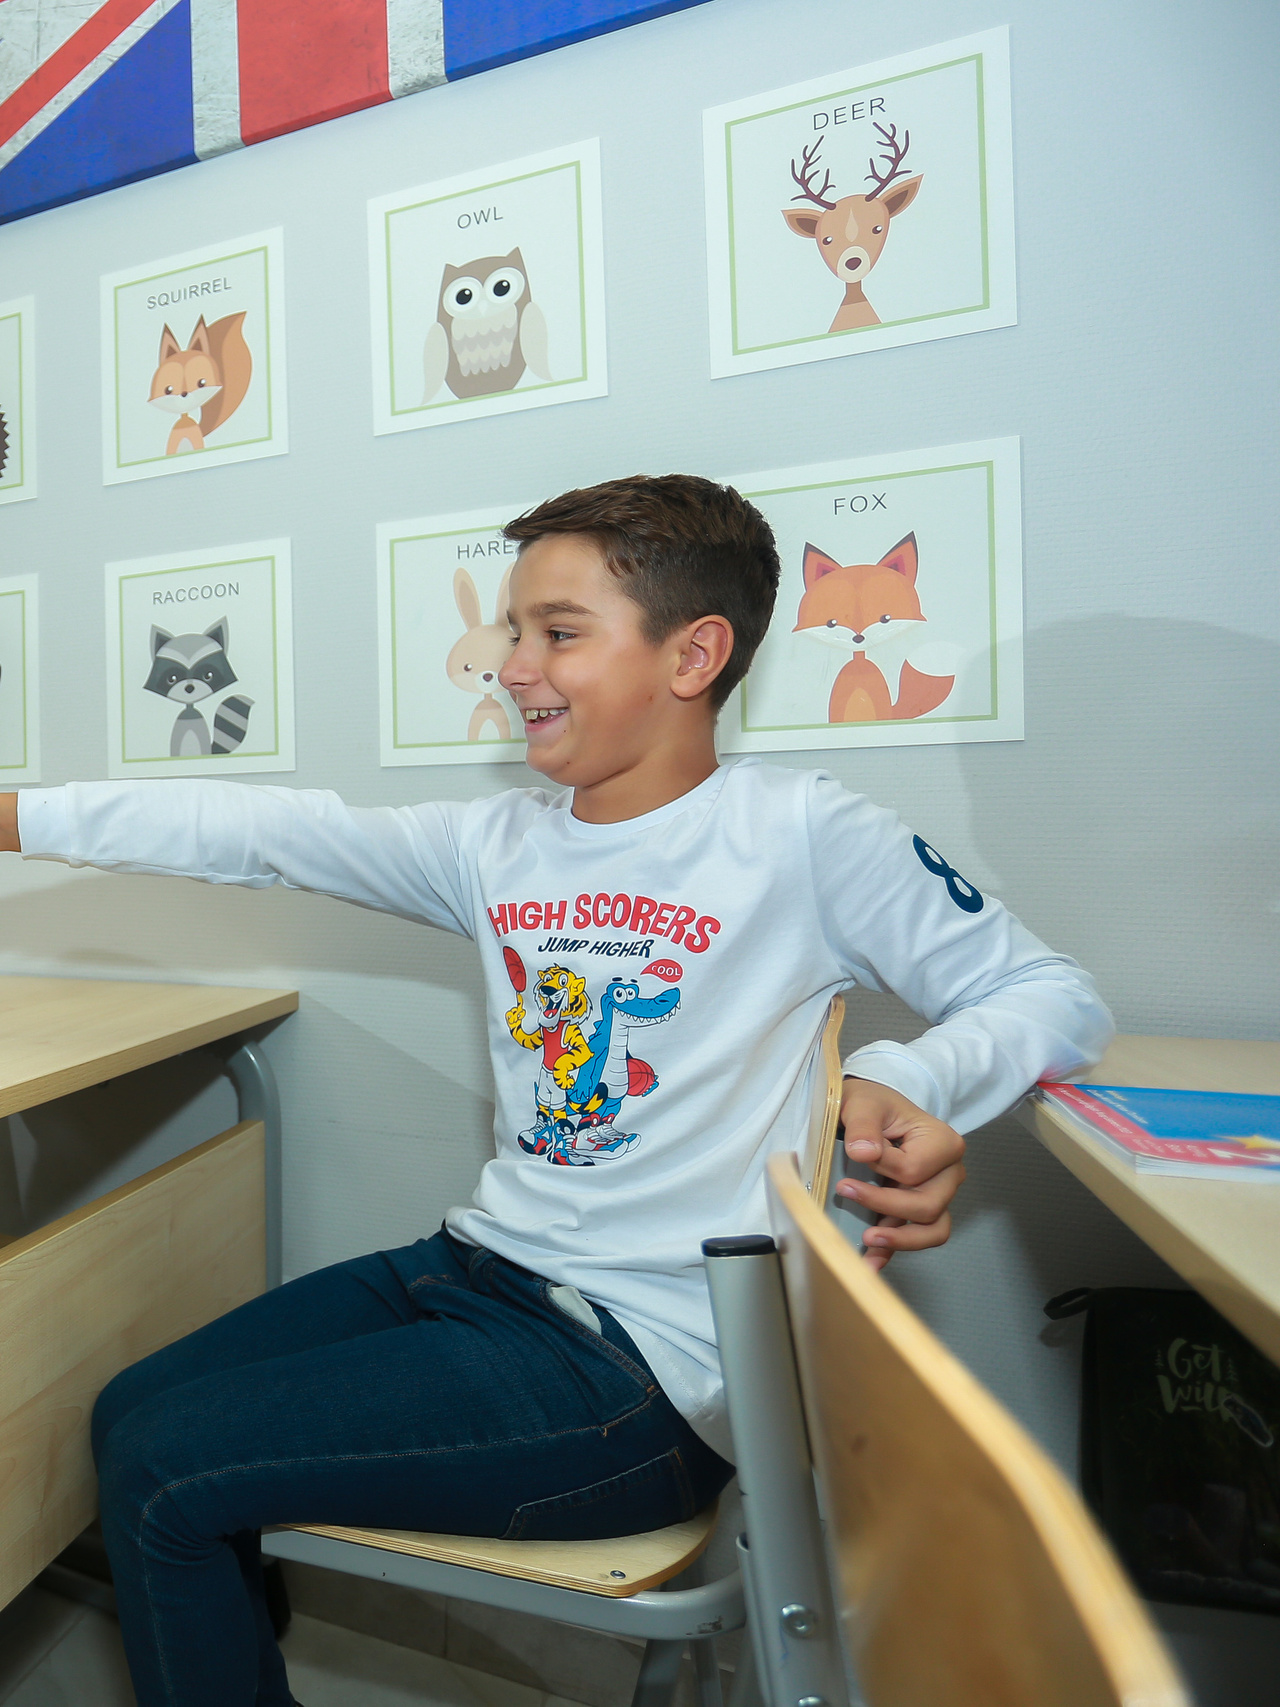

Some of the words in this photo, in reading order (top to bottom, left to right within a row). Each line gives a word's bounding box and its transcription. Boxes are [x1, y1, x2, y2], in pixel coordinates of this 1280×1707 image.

[813, 95, 887, 131] DEER
[456, 206, 504, 231] OWL
[146, 276, 232, 310] SQUIRREL
[832, 492, 888, 516] FOX
[456, 539, 515, 560] HARE
[152, 581, 241, 606] RACCOON
[912, 833, 984, 914] 8
[486, 899, 568, 938] HIGH
[572, 892, 722, 955] SCORERS
[538, 936, 589, 953] JUMP
[587, 938, 655, 959] HIGHER
[651, 965, 681, 977] COOL
[1167, 1337, 1224, 1382] Get
